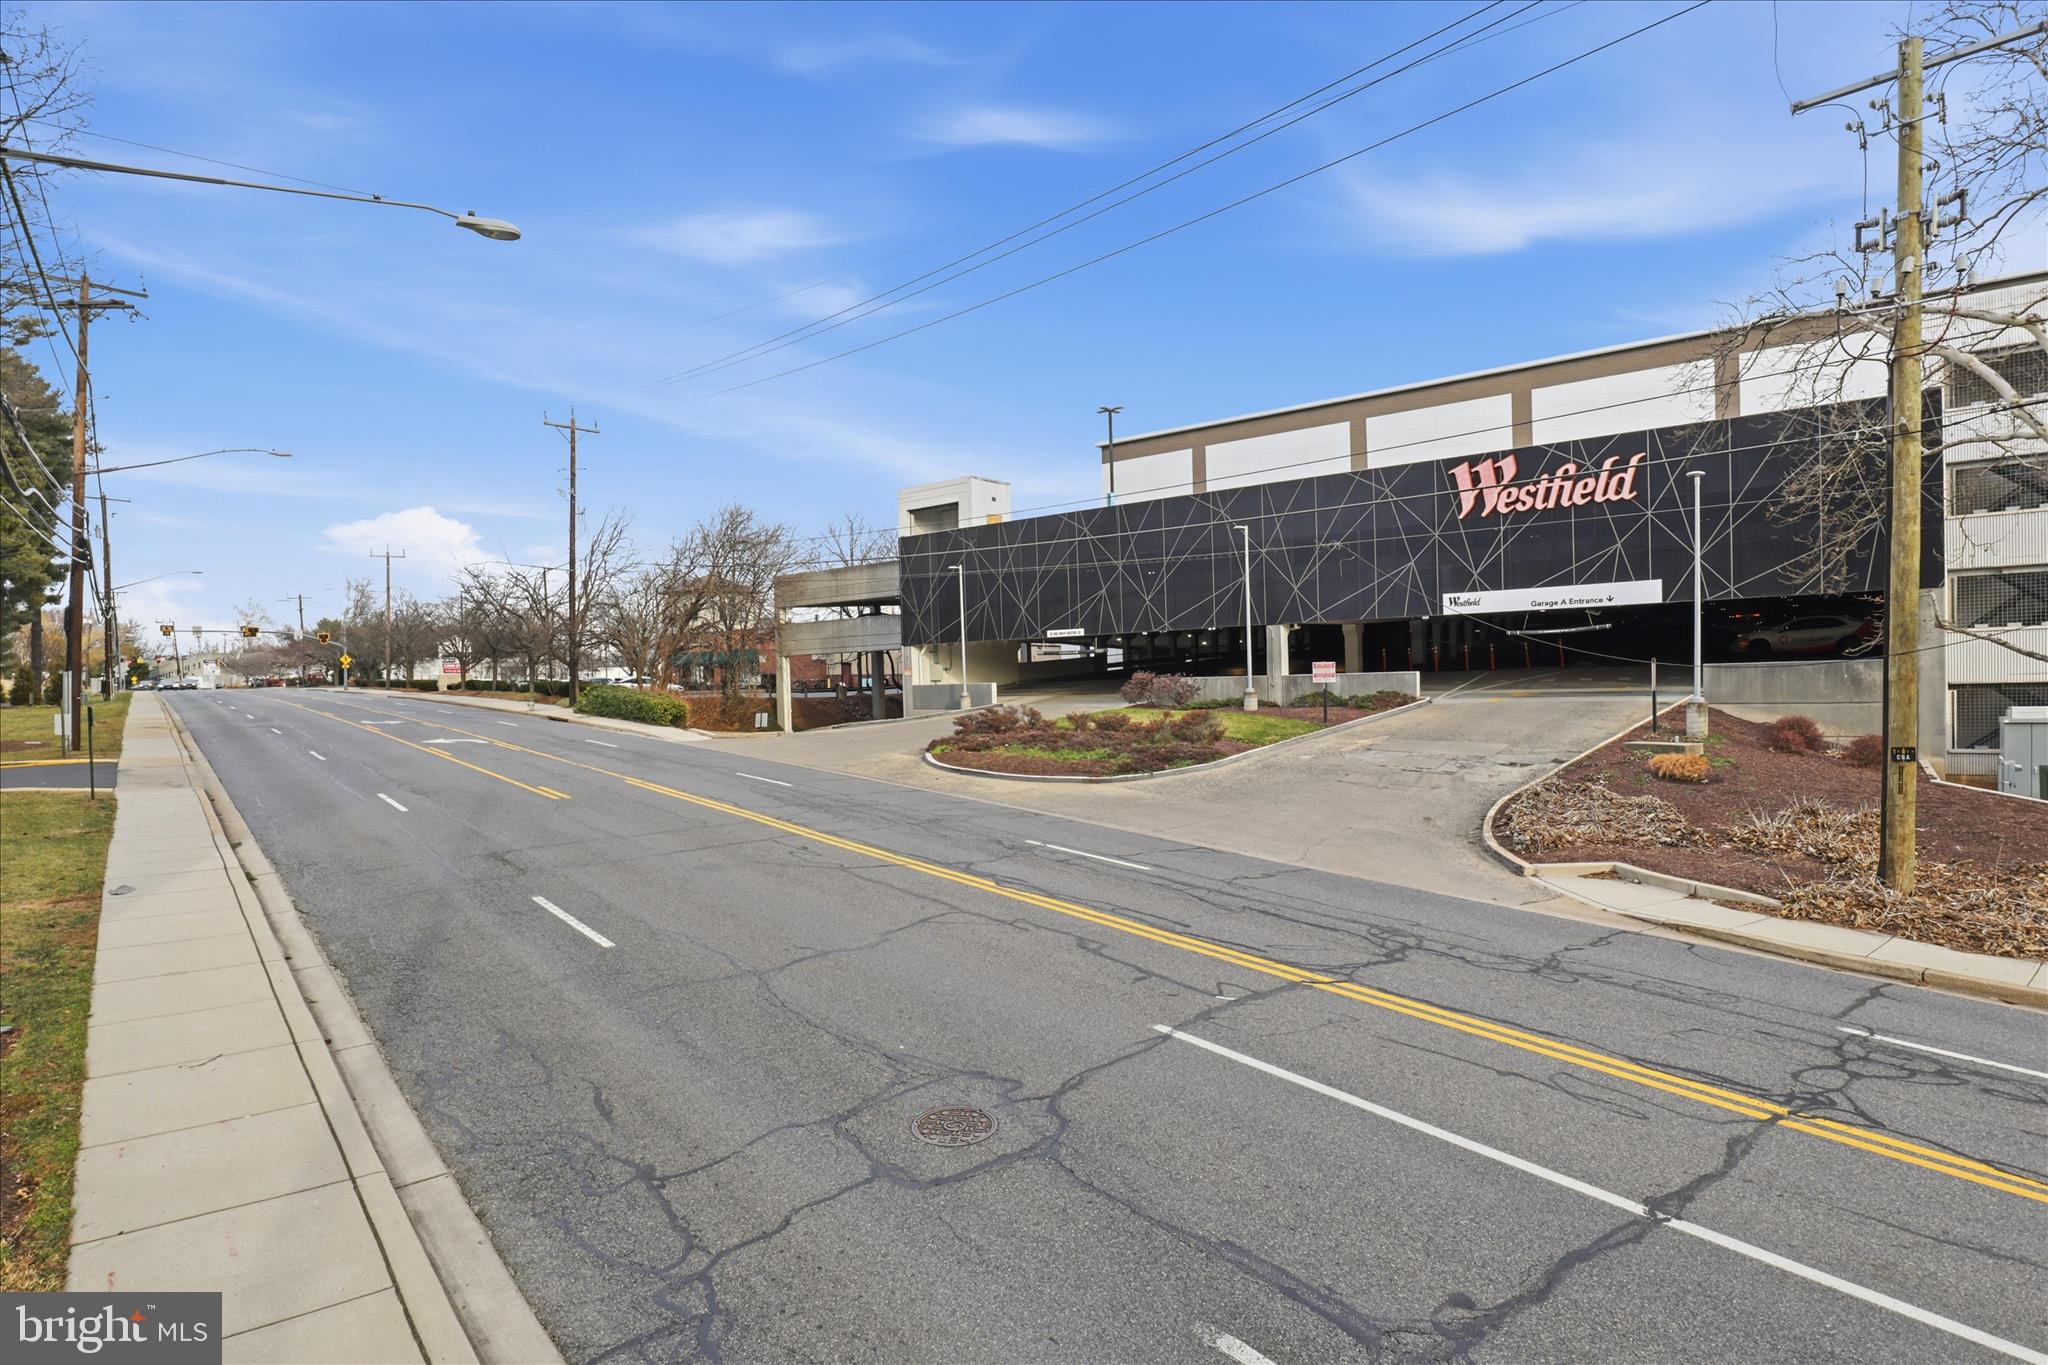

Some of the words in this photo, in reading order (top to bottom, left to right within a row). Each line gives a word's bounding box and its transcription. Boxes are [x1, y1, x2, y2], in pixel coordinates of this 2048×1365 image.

[1448, 452, 1647, 520] Westfield
[1449, 597, 1481, 607] Westfield
[1530, 600, 1558, 608] Garage
[1569, 597, 1604, 605] Entrance
